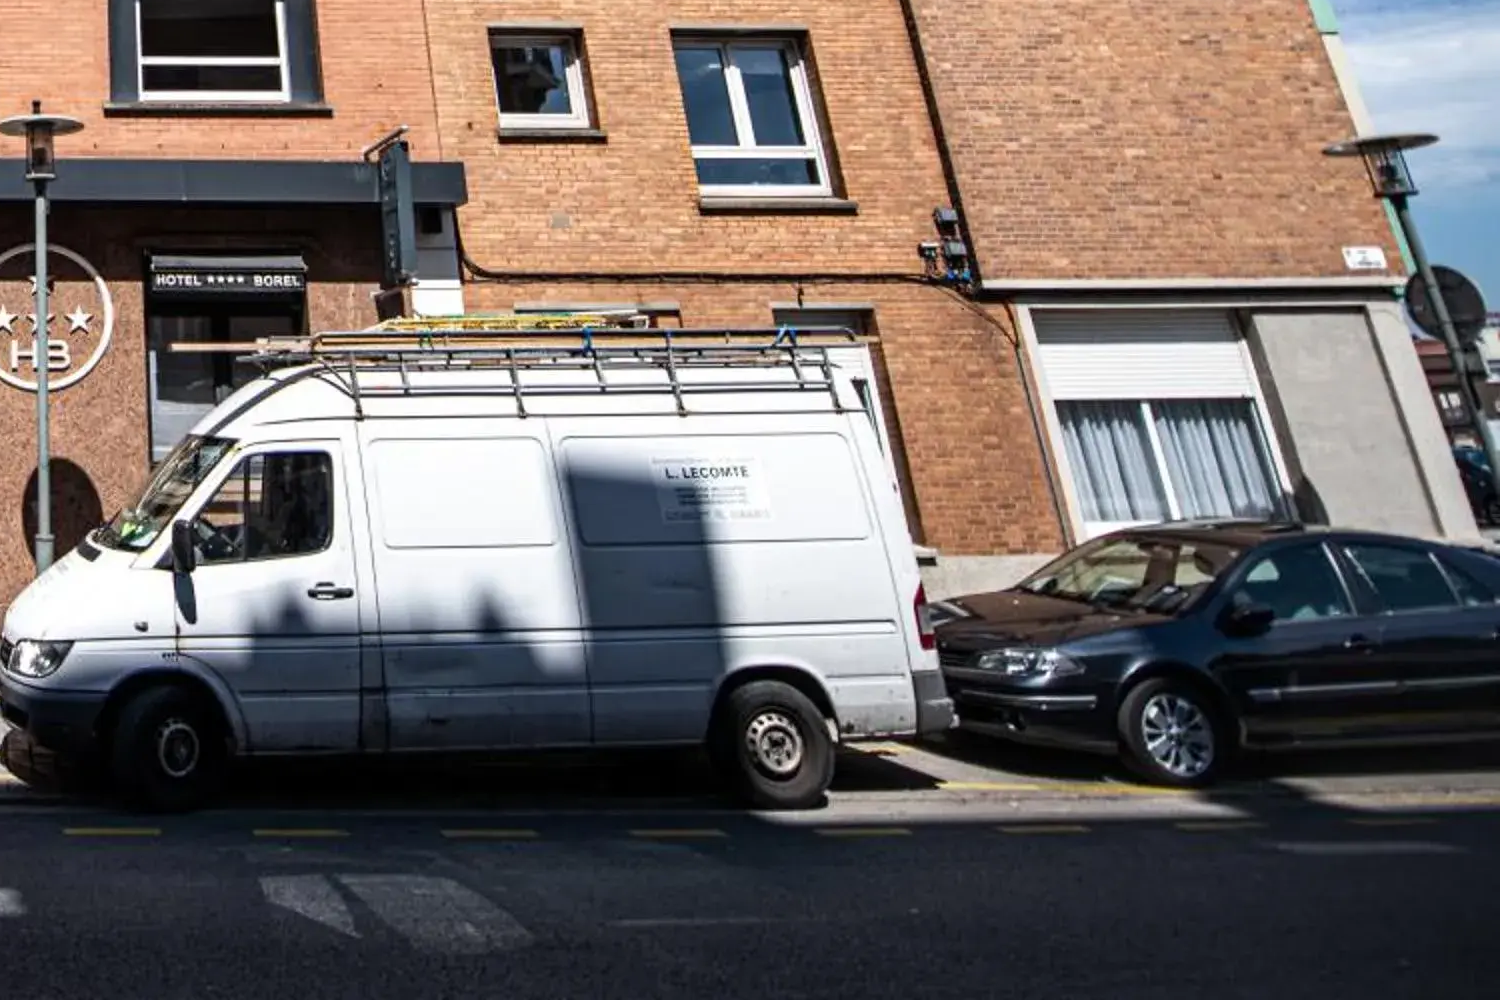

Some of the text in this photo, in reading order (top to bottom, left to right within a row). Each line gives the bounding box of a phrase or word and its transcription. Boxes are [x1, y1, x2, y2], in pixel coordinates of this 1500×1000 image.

[156, 274, 301, 287] HOTEL BOREL
[11, 338, 71, 369] HB
[665, 465, 750, 480] L. LECOMTE
